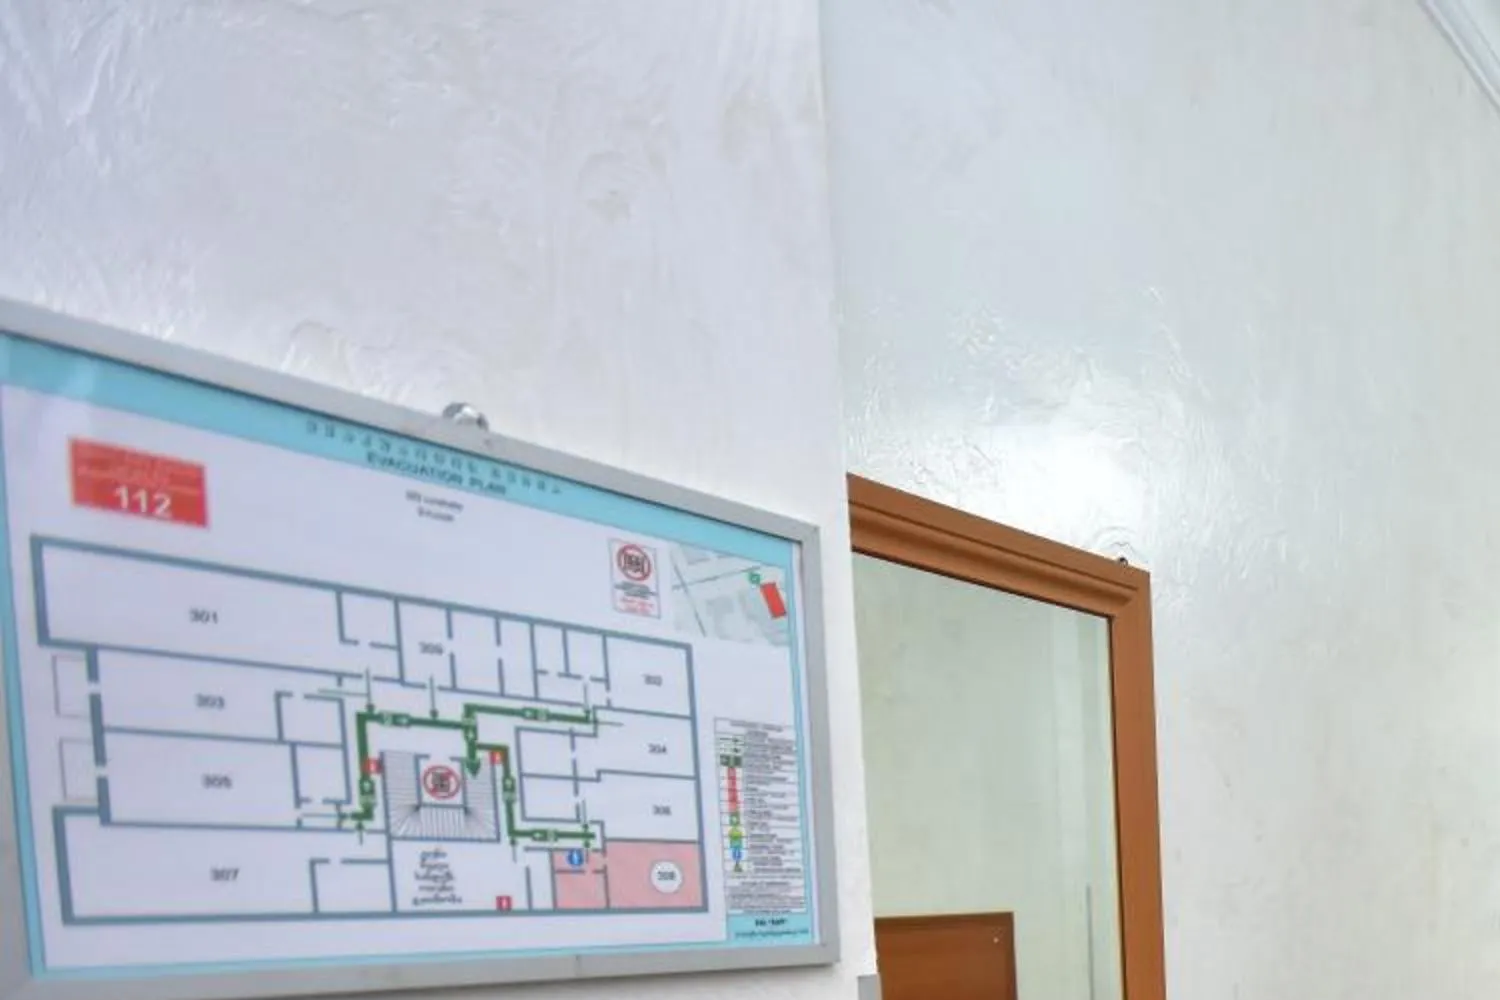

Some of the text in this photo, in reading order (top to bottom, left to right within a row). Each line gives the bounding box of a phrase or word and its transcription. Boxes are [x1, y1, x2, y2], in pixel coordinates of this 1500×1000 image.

[367, 450, 463, 486] EVACUATION
[468, 475, 507, 496] PLAN
[114, 484, 173, 519] 112
[189, 607, 219, 625] 301
[209, 867, 241, 883] 307
